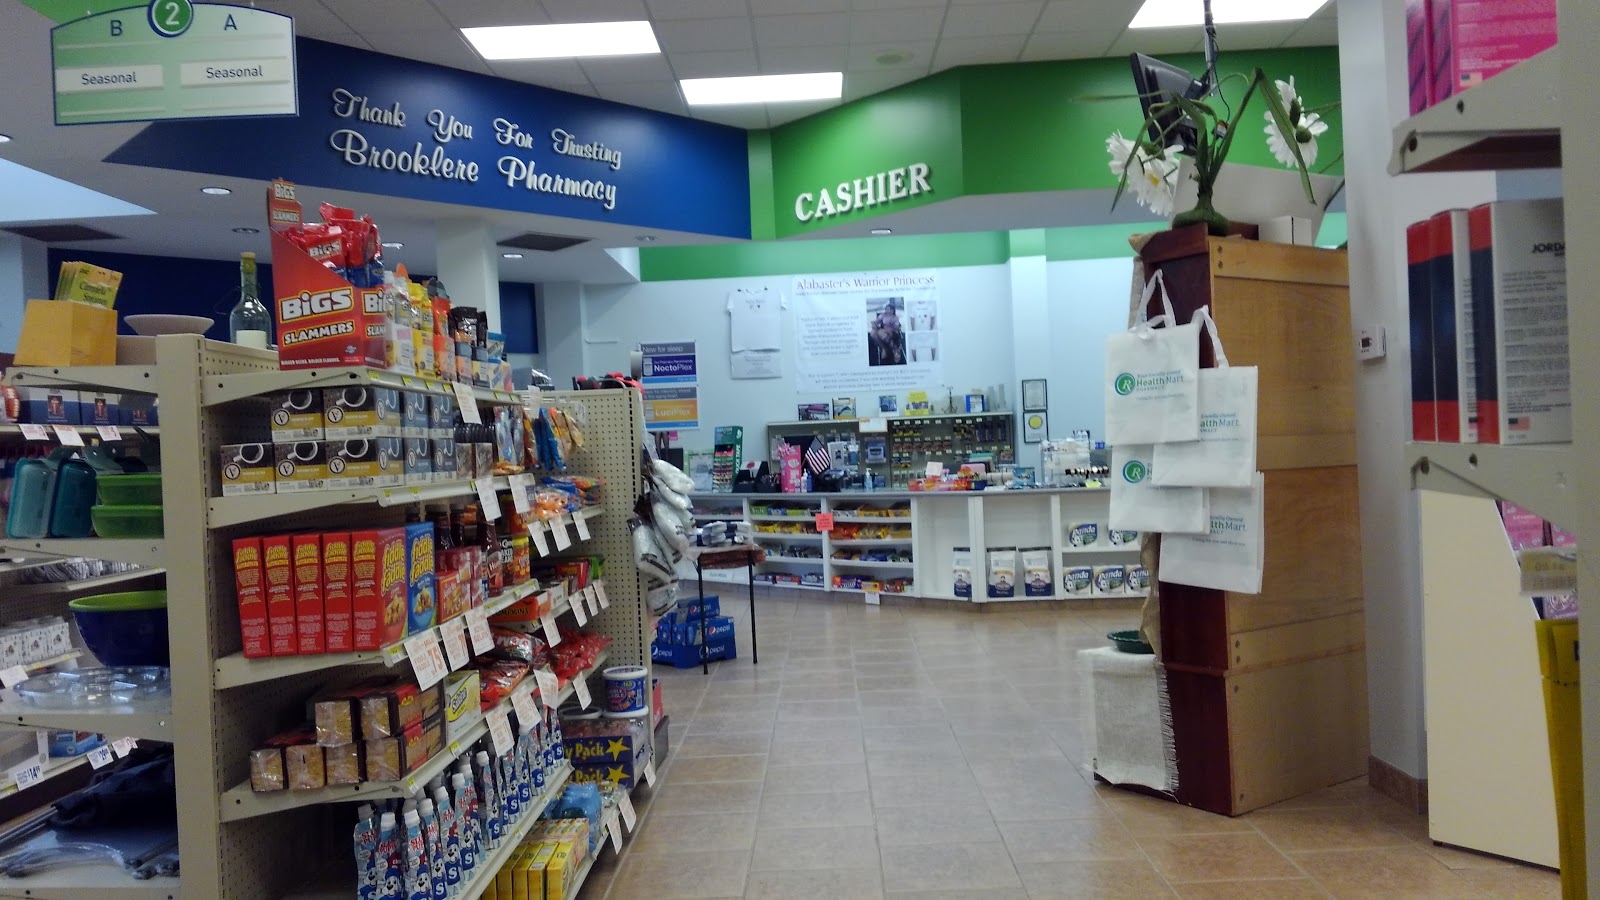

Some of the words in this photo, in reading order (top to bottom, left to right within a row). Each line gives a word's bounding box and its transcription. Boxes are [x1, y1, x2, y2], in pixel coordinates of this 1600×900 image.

[165, 1, 179, 26] 2
[110, 20, 123, 36] B
[224, 14, 237, 31] A
[81, 71, 137, 86] Seasonal
[206, 65, 263, 79] Seasonal
[332, 88, 406, 127] Thank
[427, 109, 473, 143] You
[492, 117, 533, 149] For
[551, 127, 622, 170] Trusting
[330, 129, 479, 182] Brooklere
[497, 156, 617, 210] Pharmacy
[795, 162, 931, 221] CASHIER
[797, 278, 851, 290] Alabaster's
[854, 276, 889, 287] Warrior
[893, 274, 934, 285] Princess
[284, 322, 353, 344] SLAMMERS
[653, 364, 692, 372] NoctoPlex
[1136, 377, 1165, 387] Health
[1073, 525, 1095, 535] Panda
[1066, 570, 1089, 580] Panda
[1100, 569, 1122, 580] Panda
[716, 624, 731, 633] pepsi
[658, 649, 673, 657] pepsi
[709, 645, 725, 653] pepsi
[575, 742, 604, 757] Pack
[448, 867, 456, 879] S
